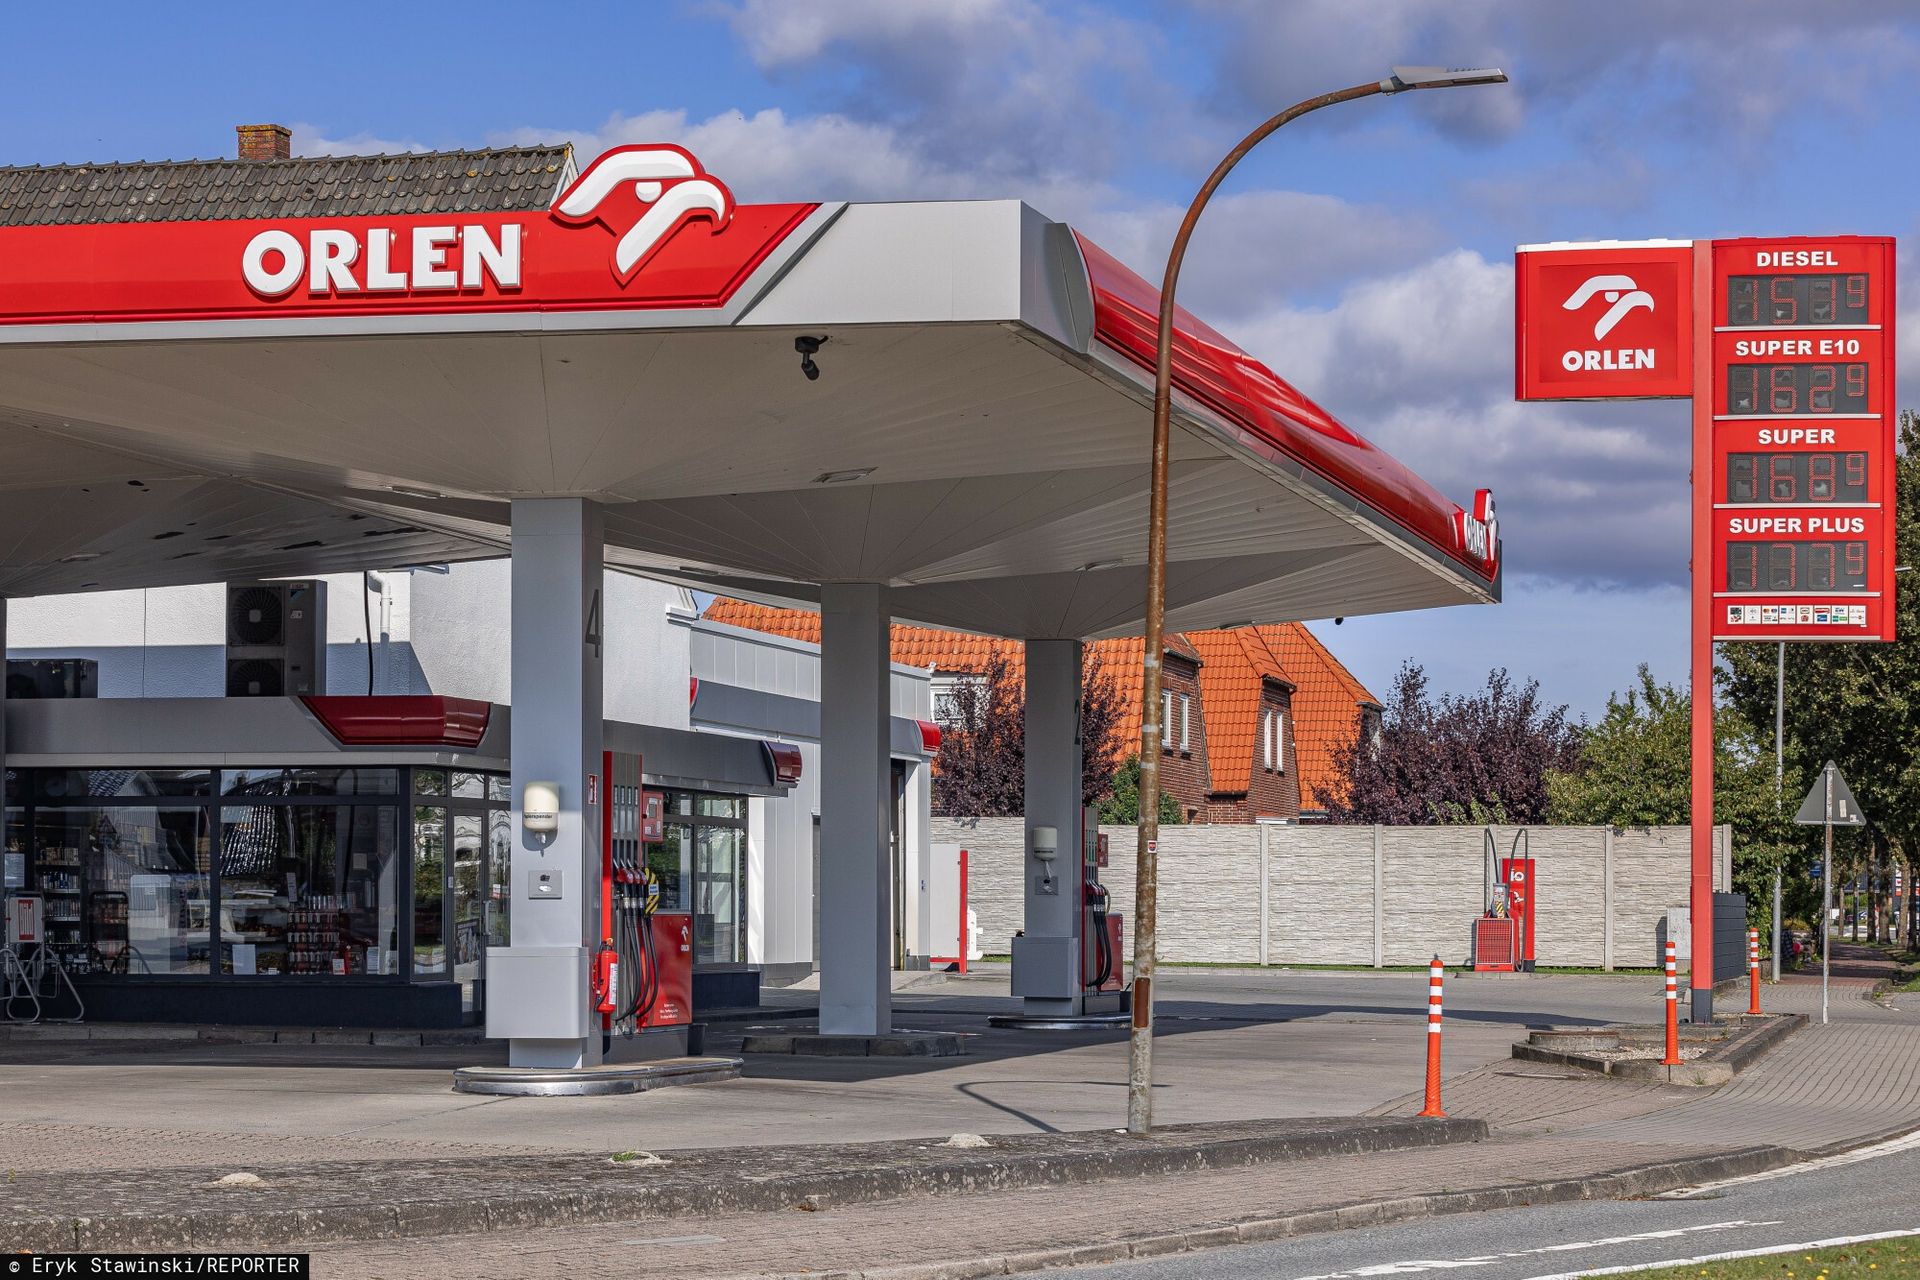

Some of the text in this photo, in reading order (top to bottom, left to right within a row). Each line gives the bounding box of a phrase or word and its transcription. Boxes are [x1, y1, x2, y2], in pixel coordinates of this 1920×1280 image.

[241, 222, 522, 296] ORLEN
[1756, 251, 1839, 267] DIESEL
[1735, 339, 1860, 356] SUPER E10
[1562, 348, 1655, 372] ORLEN
[1758, 429, 1836, 444] SUPER
[1729, 517, 1865, 533] SUPER PLUS
[585, 589, 601, 658] 4
